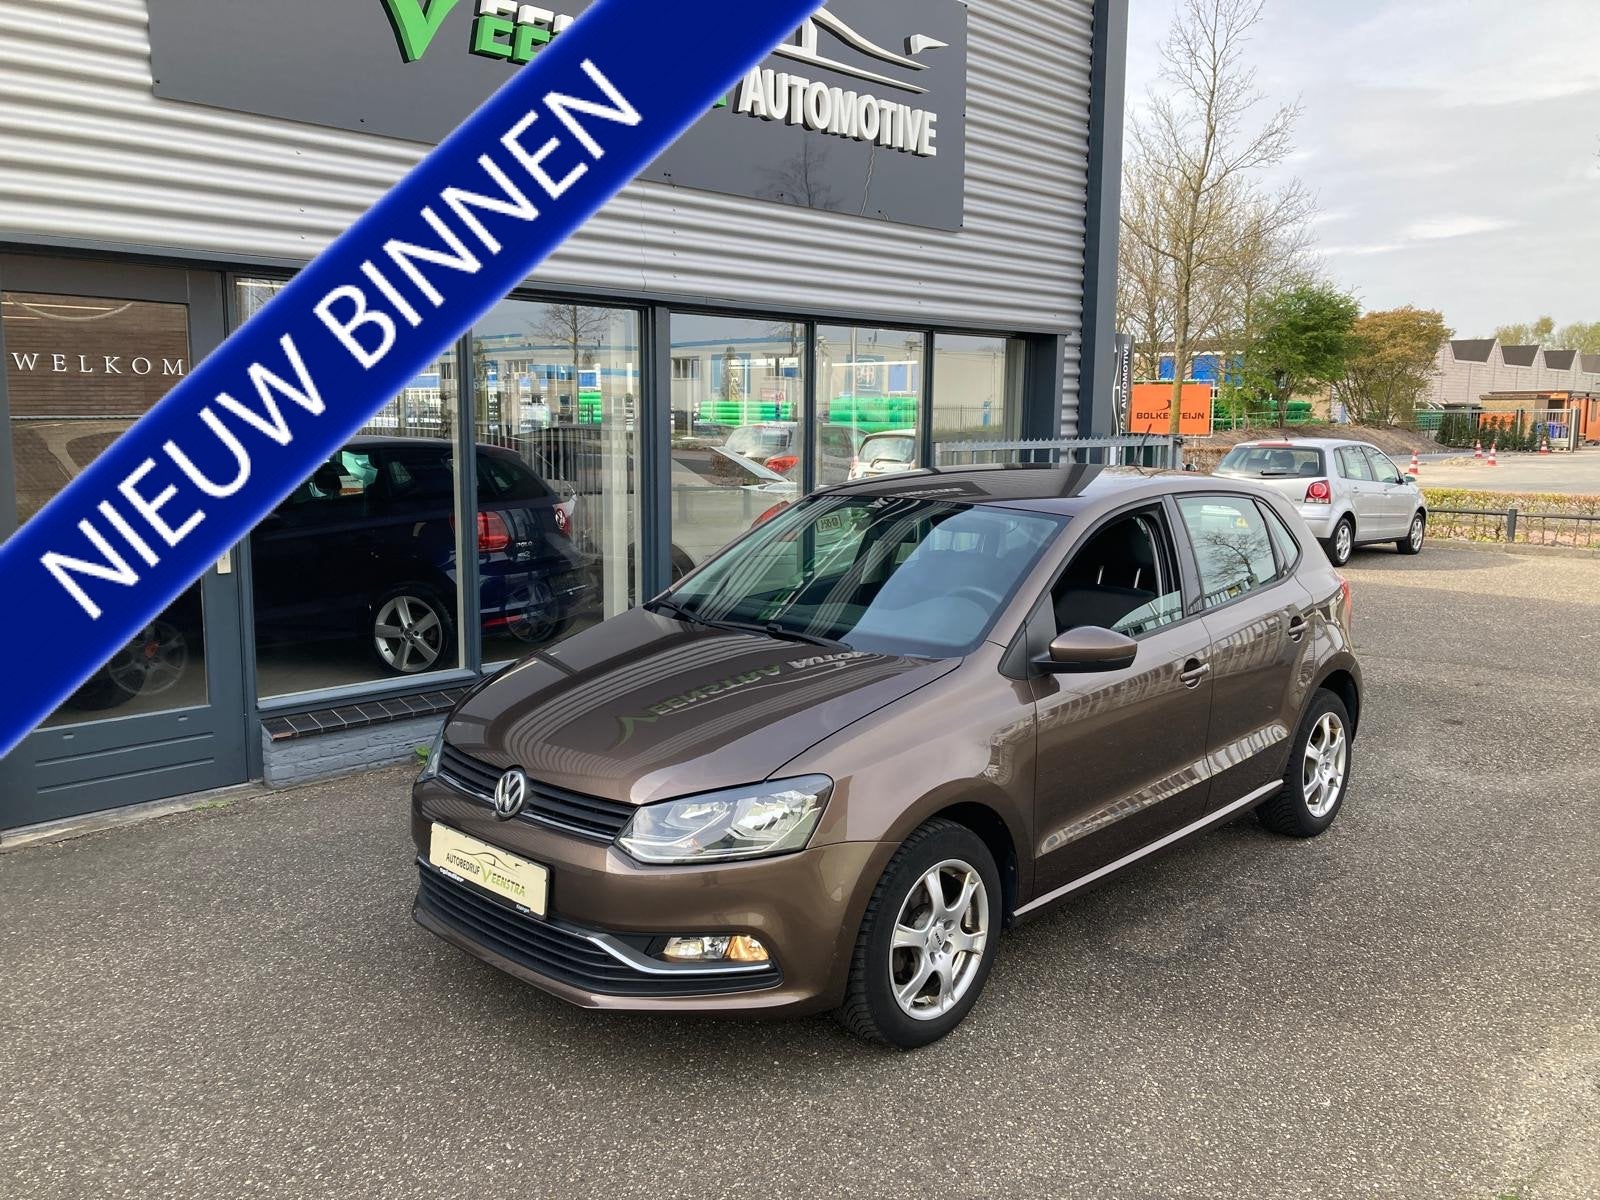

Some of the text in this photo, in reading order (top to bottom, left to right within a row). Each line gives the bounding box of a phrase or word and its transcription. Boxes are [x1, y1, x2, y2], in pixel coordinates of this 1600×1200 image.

[737, 65, 938, 157] AUTOMOTIVE
[11, 352, 185, 376] WELKOM
[1121, 343, 1129, 408] AUTOMOTIVE
[1136, 412, 1205, 420] BOLKEEIJN
[445, 852, 481, 876] AUTOBEDRIJF
[474, 856, 526, 897] VEENSTRA
